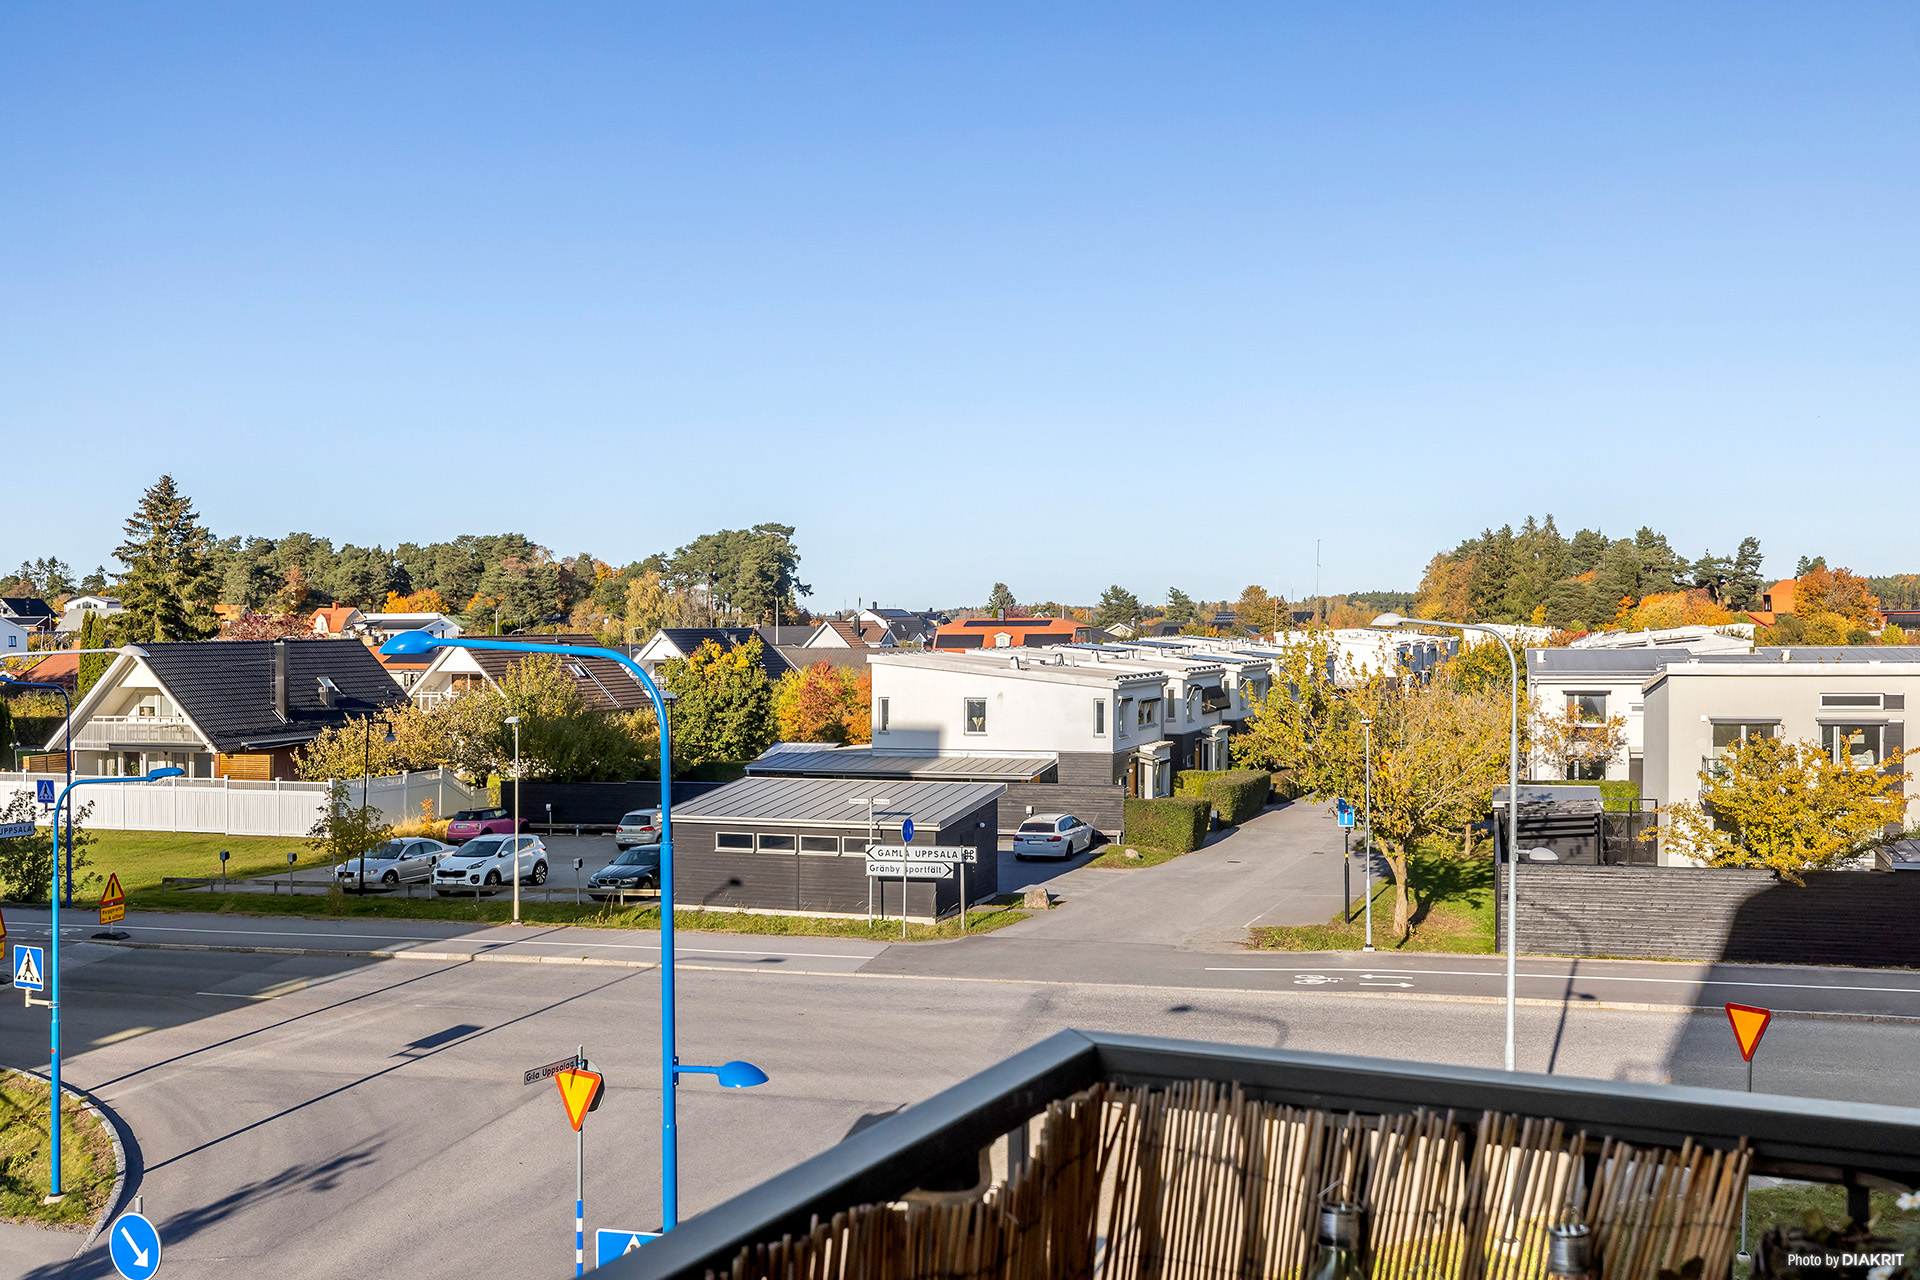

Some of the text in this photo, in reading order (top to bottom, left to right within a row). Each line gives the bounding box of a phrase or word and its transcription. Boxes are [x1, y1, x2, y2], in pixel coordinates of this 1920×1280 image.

[0, 825, 32, 835] UPPSALA
[877, 849, 958, 858] GAMLA UPPSALA
[869, 864, 900, 874] Gränby
